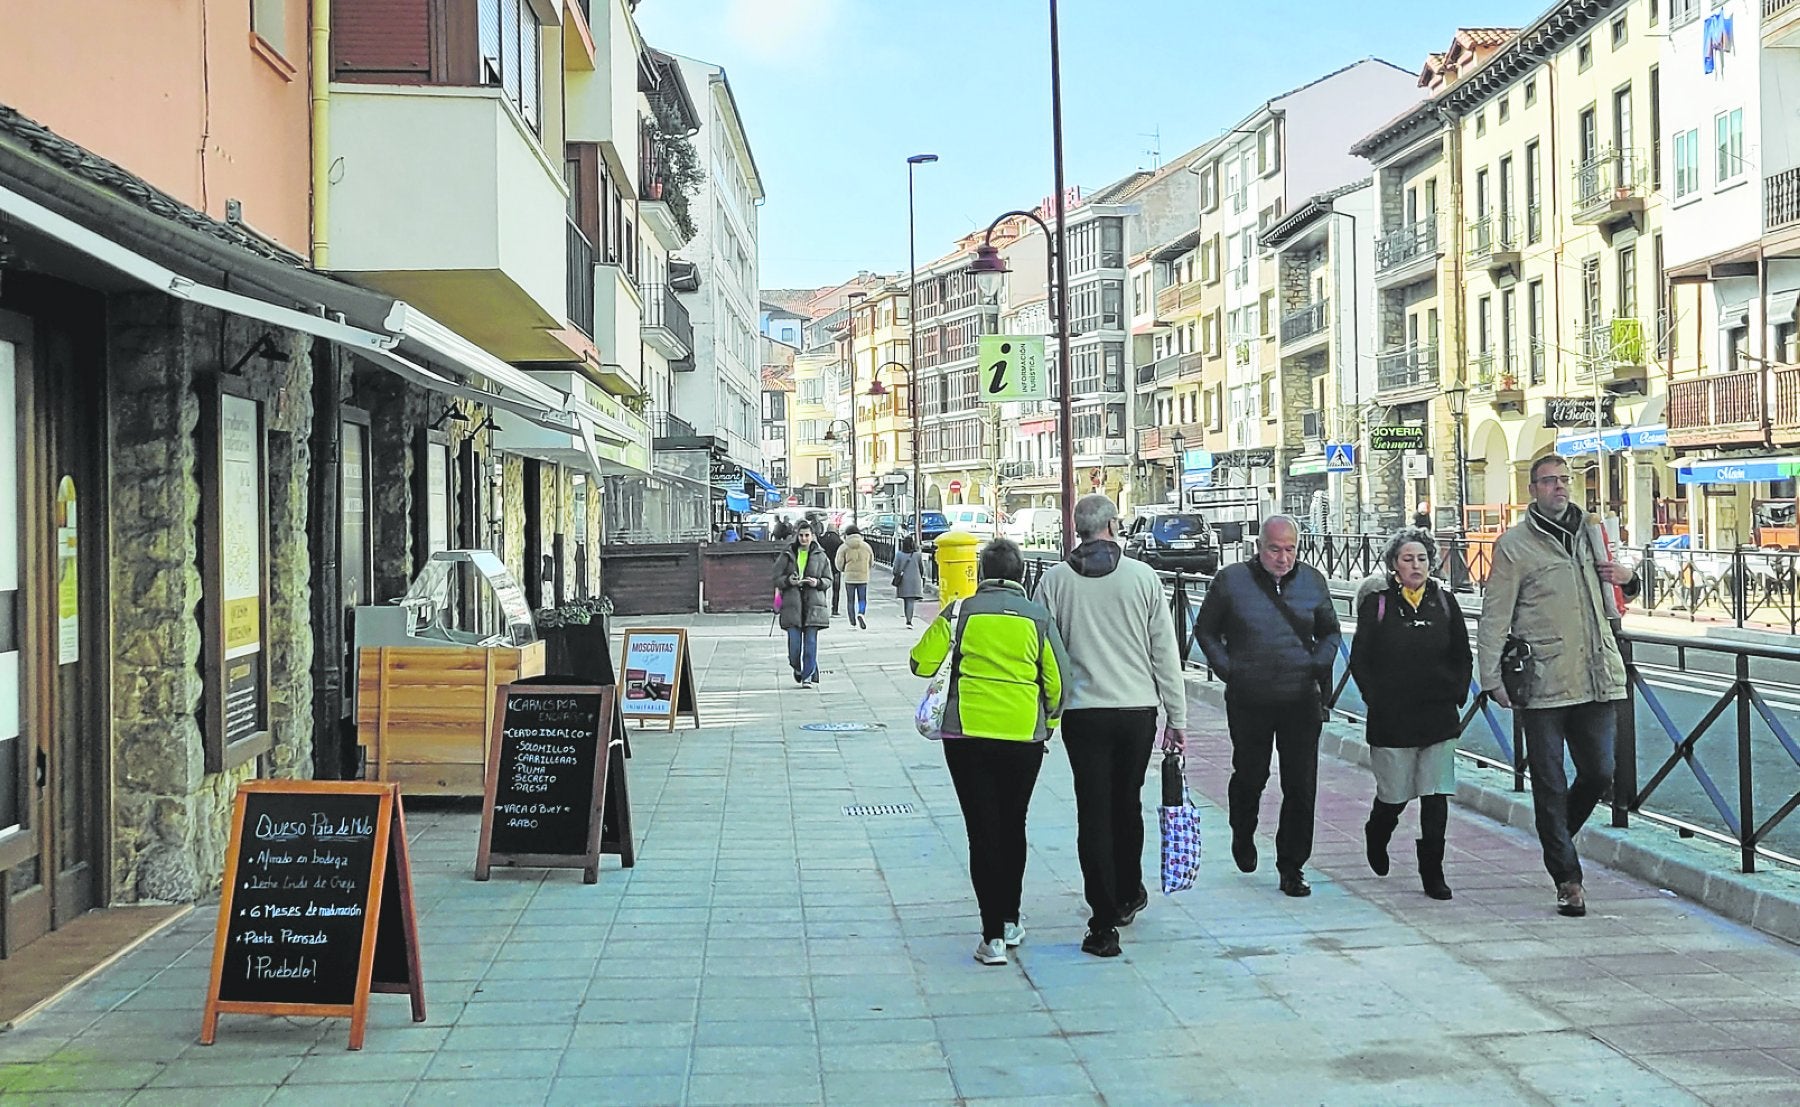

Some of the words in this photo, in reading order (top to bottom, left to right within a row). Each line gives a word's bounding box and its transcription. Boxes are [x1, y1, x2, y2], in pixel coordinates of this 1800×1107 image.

[1373, 427, 1423, 436] JOYERIA
[514, 774, 557, 783] SECRETO
[250, 905, 261, 917] 6
